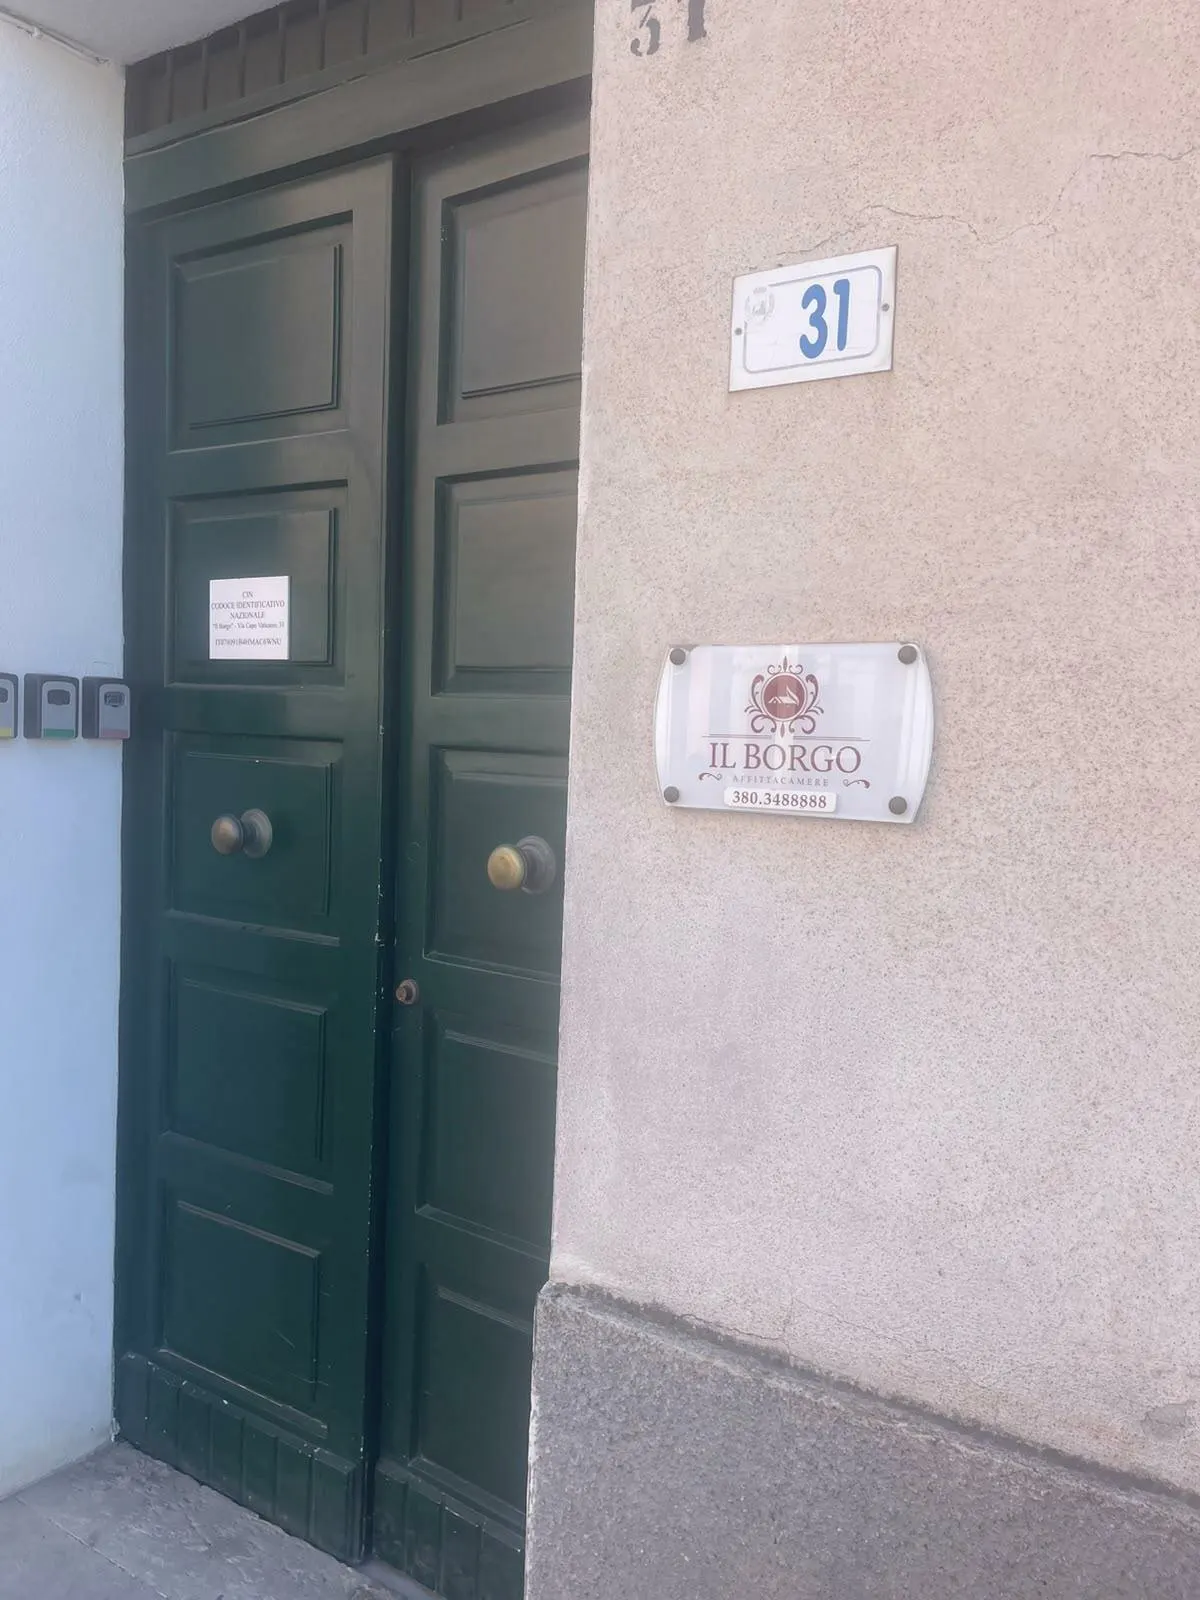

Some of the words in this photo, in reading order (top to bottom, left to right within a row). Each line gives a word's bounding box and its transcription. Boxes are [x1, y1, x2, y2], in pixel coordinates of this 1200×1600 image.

[631, 0, 707, 57] 31
[800, 278, 850, 359] 31
[236, 600, 285, 609] IDENTIFICATIVO
[230, 611, 265, 619] NAZIONALE
[708, 742, 737, 769] IL
[744, 743, 862, 774] BORGO
[732, 774, 830, 787] AFFITTACAMERE
[731, 790, 828, 809] 380.3488888
